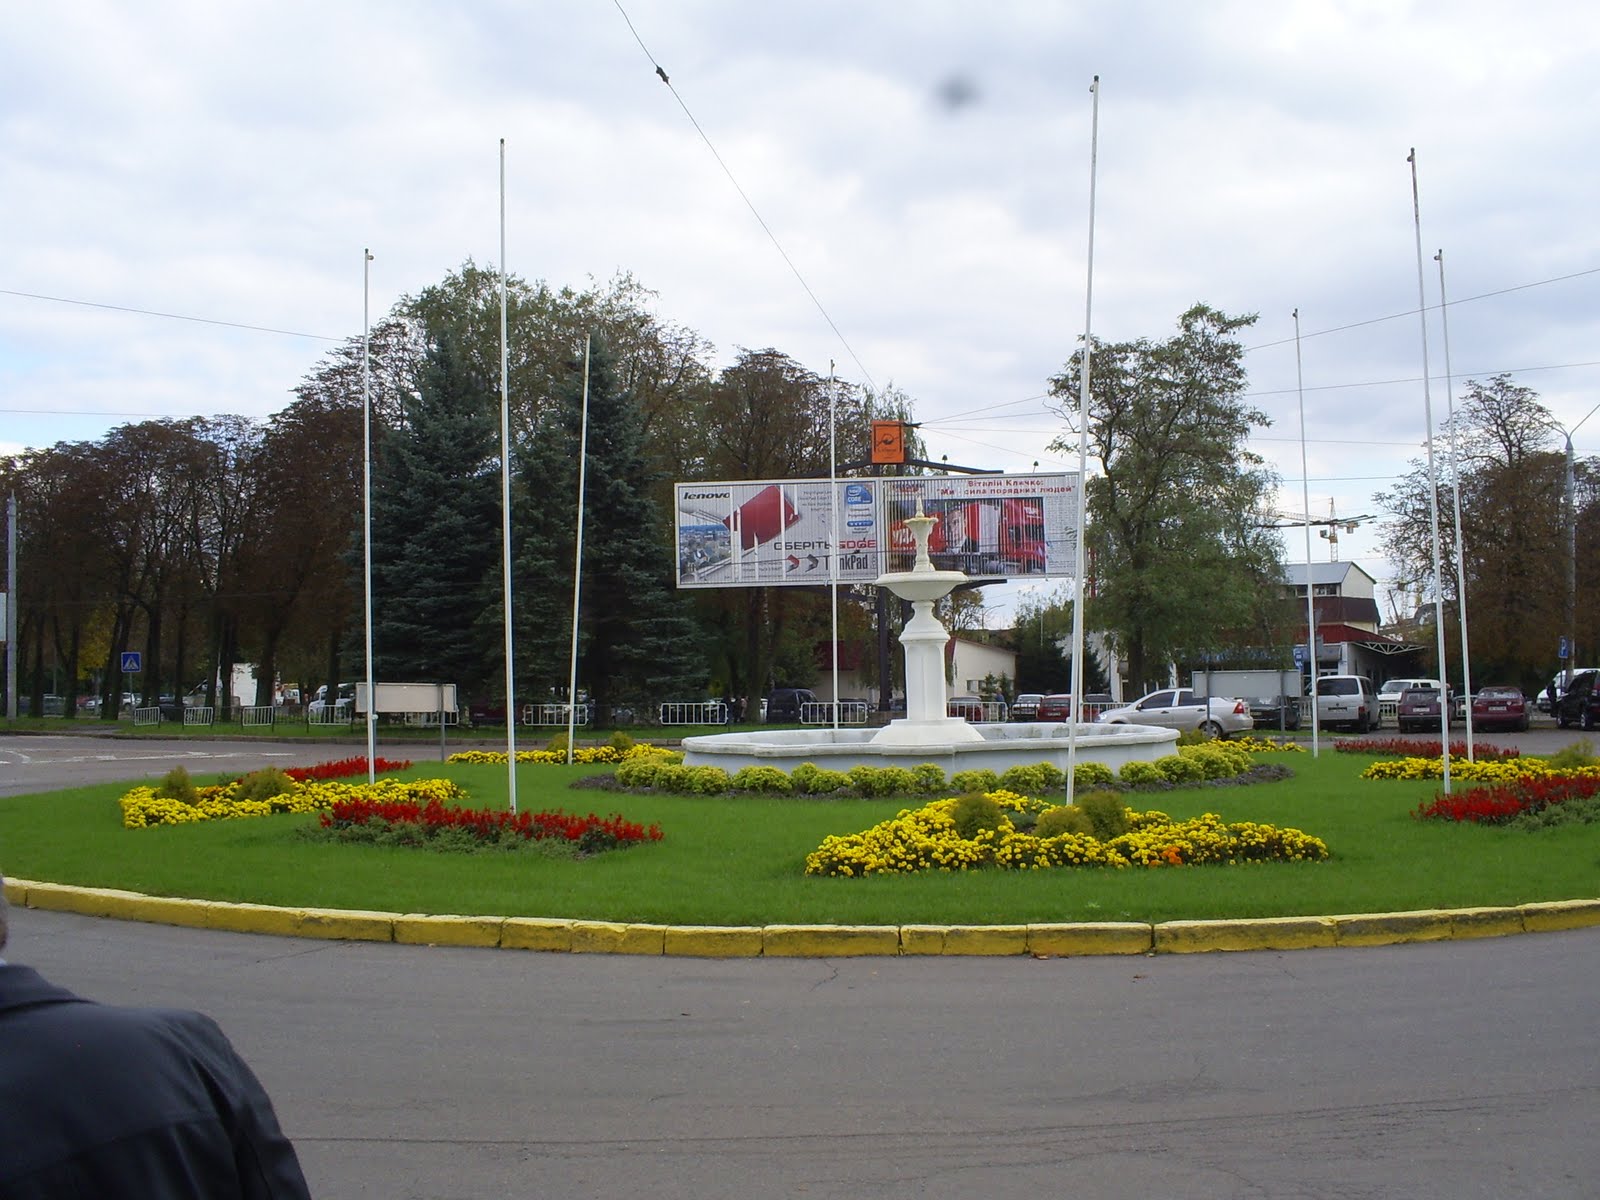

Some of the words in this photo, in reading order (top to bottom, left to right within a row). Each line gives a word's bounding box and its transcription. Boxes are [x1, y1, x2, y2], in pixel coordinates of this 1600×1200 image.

[684, 492, 730, 500] lenovo
[990, 487, 1036, 496] порядних
[823, 554, 868, 571] TnkPad
